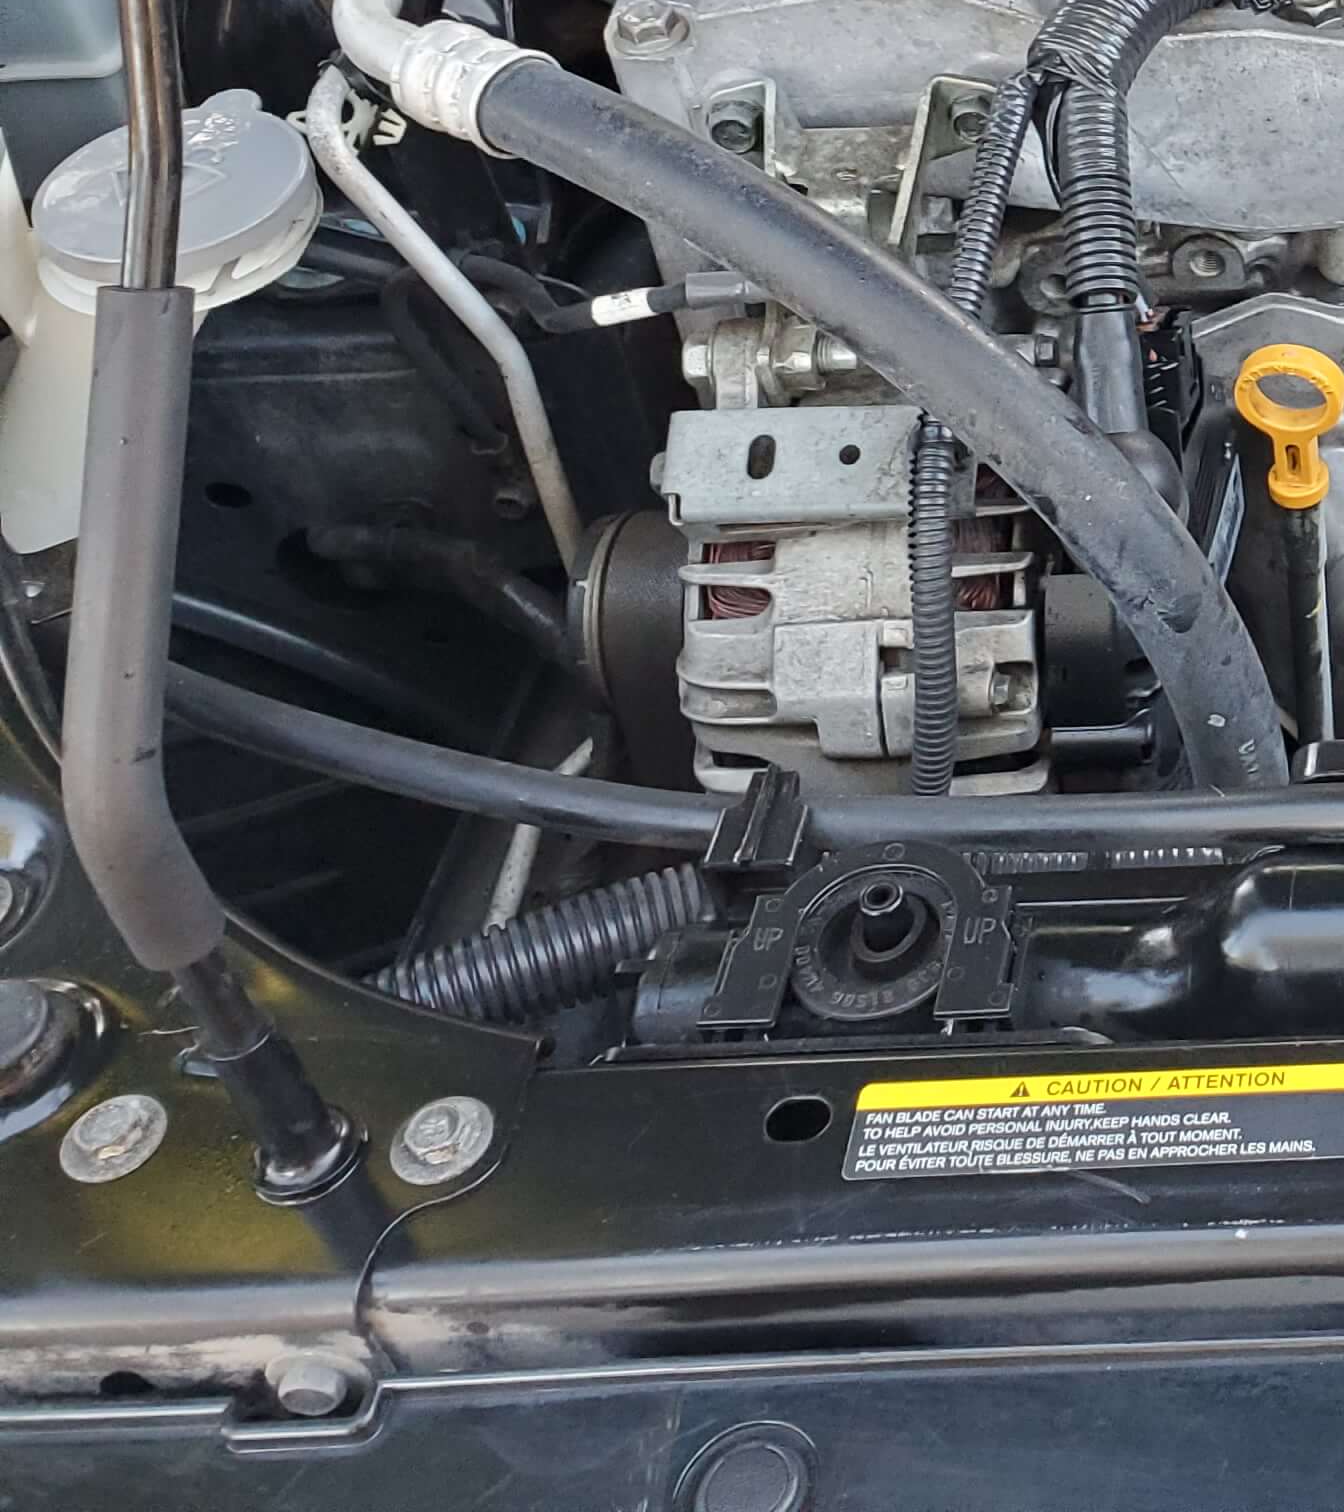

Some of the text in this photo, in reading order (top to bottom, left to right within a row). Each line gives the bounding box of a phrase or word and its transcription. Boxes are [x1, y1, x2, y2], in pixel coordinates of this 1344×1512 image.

[752, 927, 784, 951] UP
[963, 917, 996, 945] UP
[1046, 1071, 1286, 1096] CAUTION / ATTENTION
[863, 1127, 882, 1139] TO
[884, 1125, 920, 1138] HELP
[923, 1123, 966, 1136] AVOID
[968, 1120, 1042, 1135] PERSONAL
[1131, 1114, 1181, 1128] HANDS
[1183, 1111, 1232, 1126] CLEAR.
[866, 1102, 1106, 1125] FAN BLADE CAN START AT ANY TIME.
[855, 1139, 1316, 1172] POUR ÉVITER TOUTE BLESSURE, NE PAS EN APPROCHER LES MAINS.
[857, 1128, 1242, 1157] LE VENTILATEUR RISQUE DE DÉMARRER À TOUT MOMENT.
